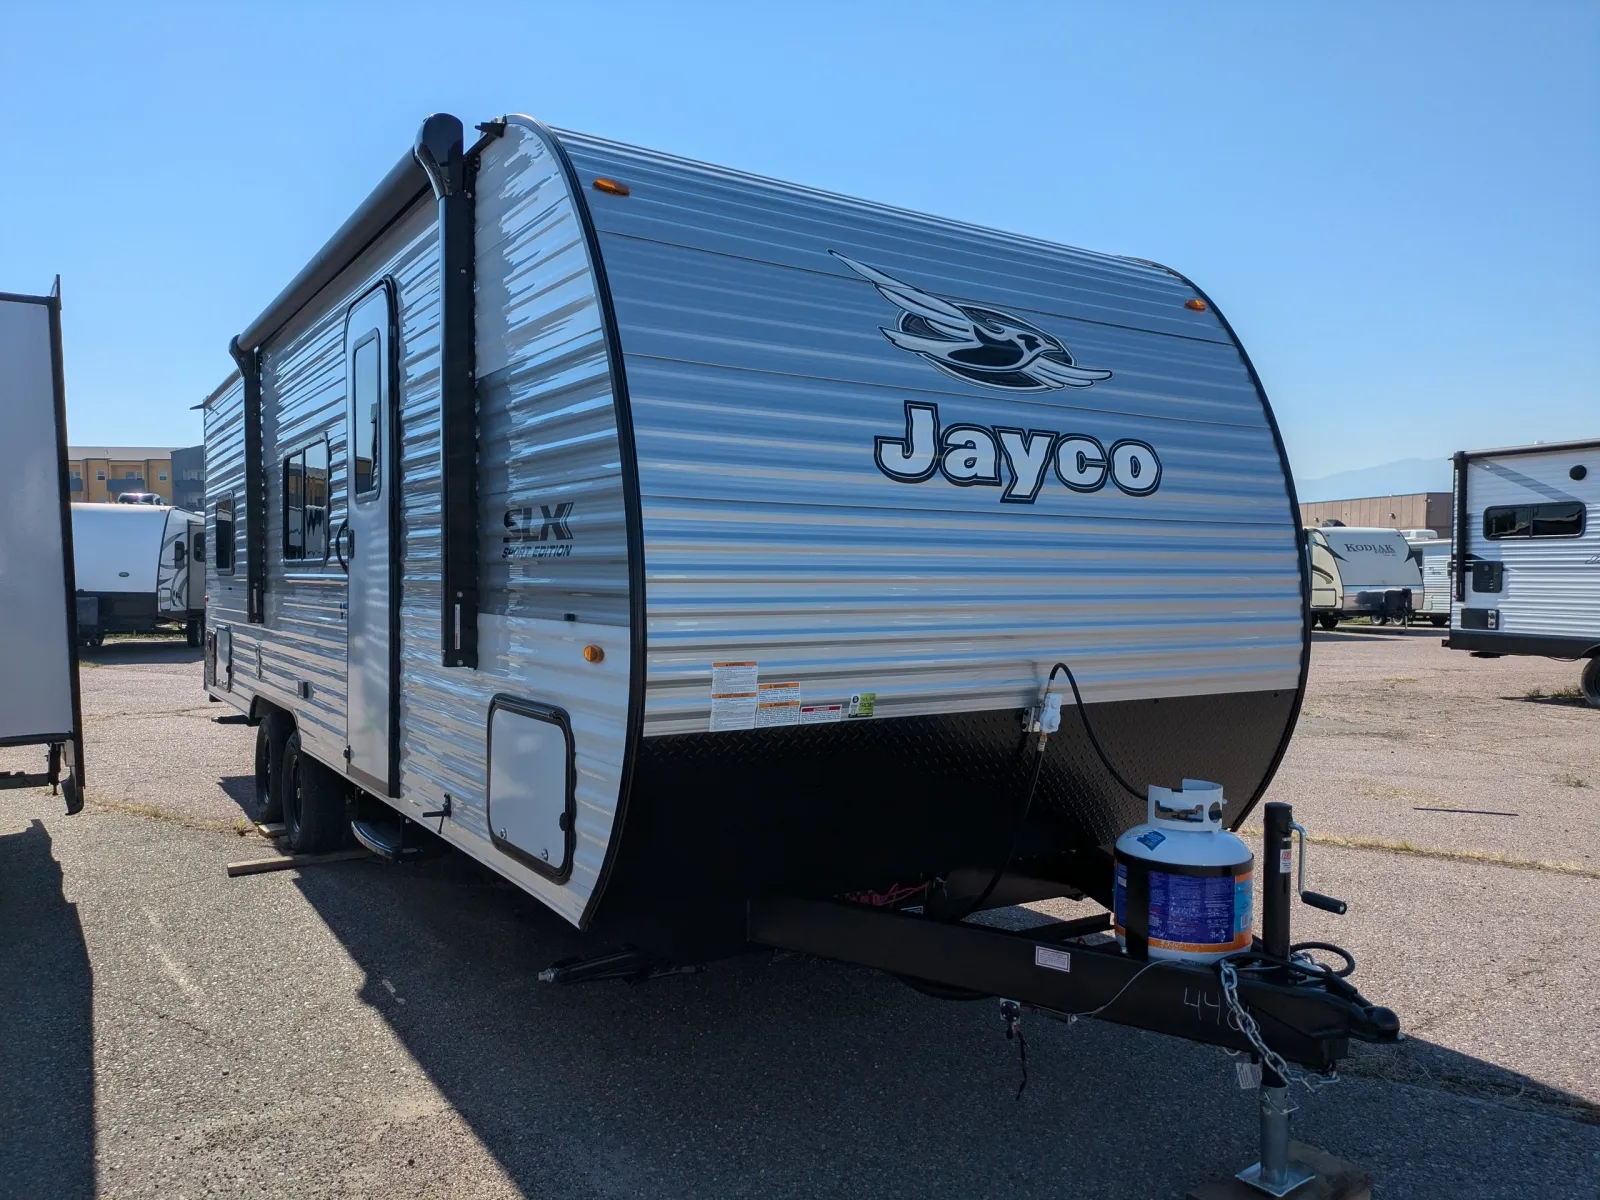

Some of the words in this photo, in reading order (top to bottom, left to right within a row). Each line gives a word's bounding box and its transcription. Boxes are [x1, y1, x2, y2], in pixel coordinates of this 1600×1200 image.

[874, 400, 1162, 504] Jayco
[503, 502, 574, 543] SLX
[532, 545, 573, 557] EDITION
[1344, 544, 1395, 553] KODIAK
